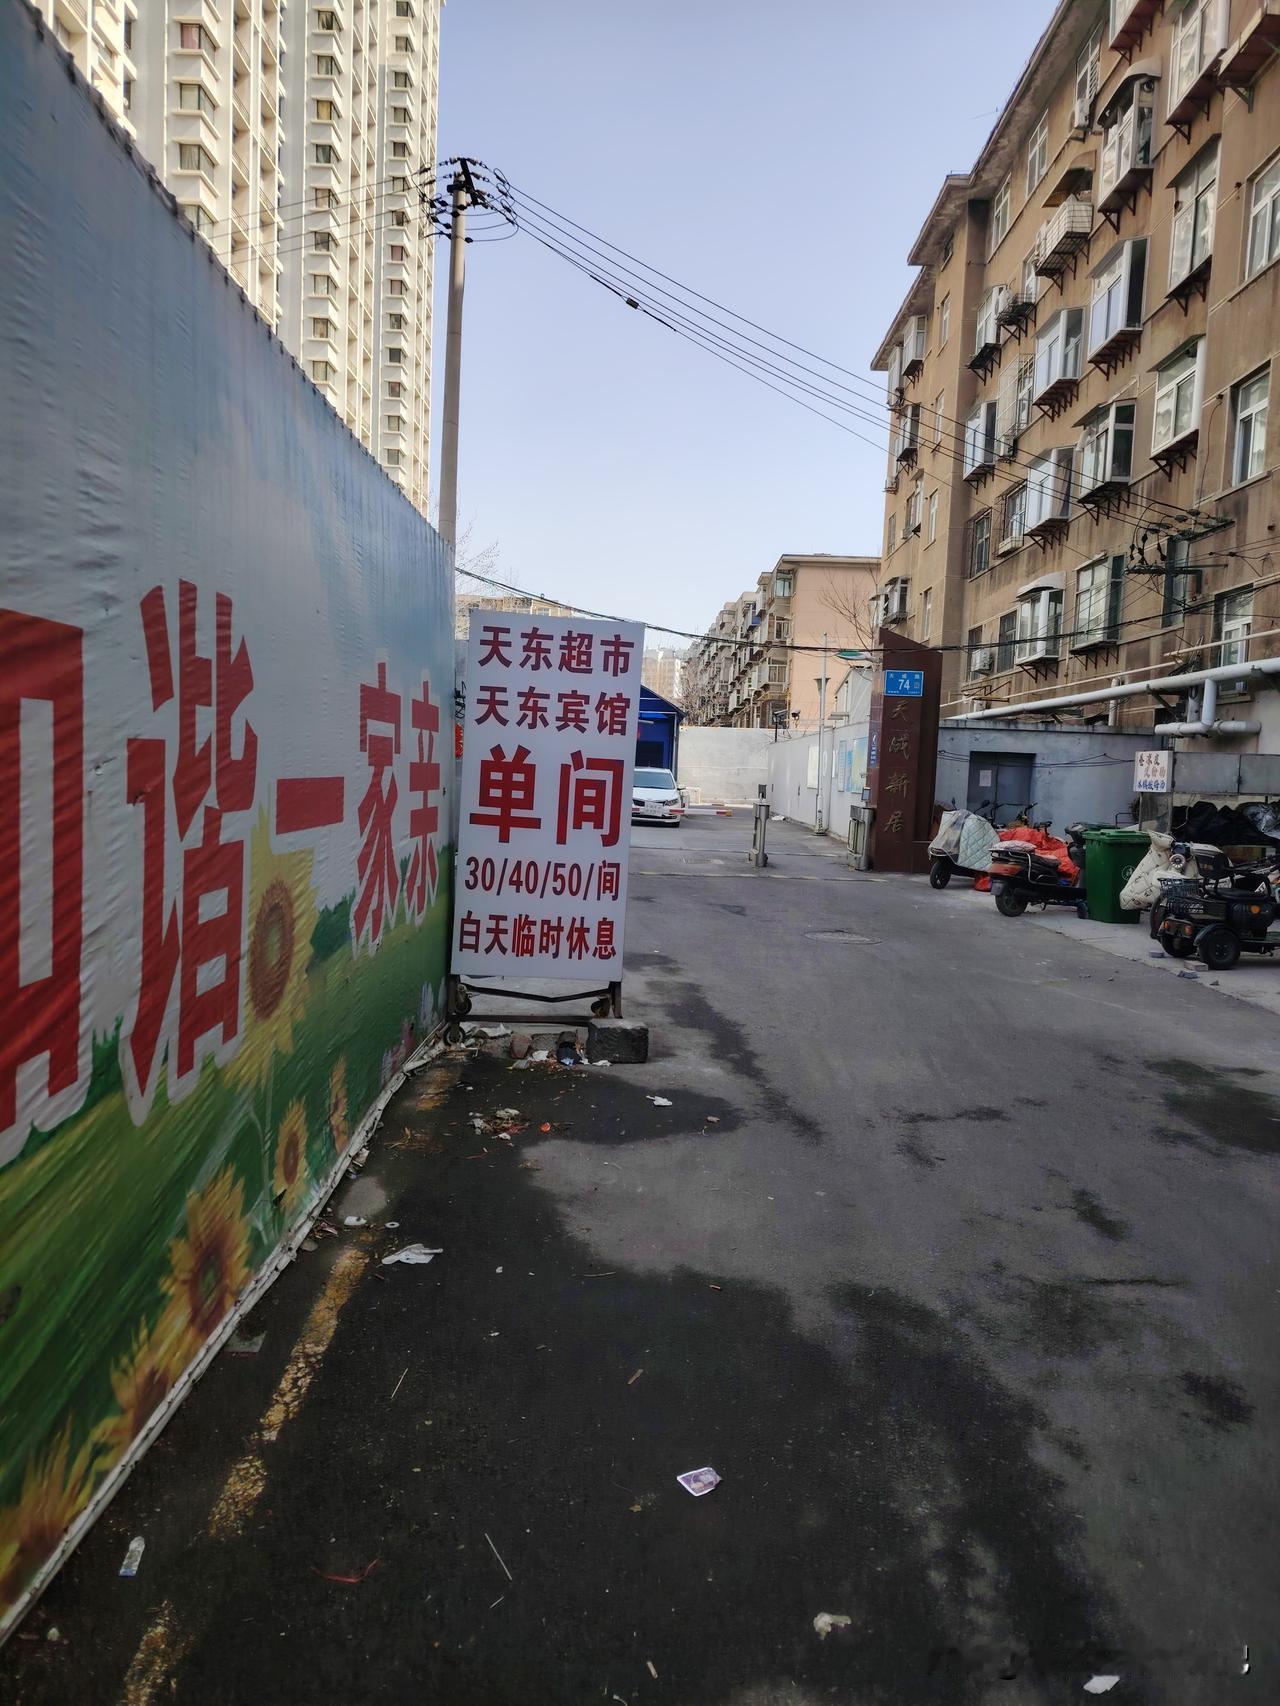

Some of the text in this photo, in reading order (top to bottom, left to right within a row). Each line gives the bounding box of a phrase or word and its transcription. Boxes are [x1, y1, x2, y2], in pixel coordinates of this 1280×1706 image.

[478, 625, 635, 678] 天东超市
[898, 679, 910, 690] 74
[475, 685, 631, 736] 天东宾馆
[469, 744, 625, 848] 单间
[464, 856, 621, 902] 30/40/50/间
[458, 909, 617, 961] 白天临时休息
